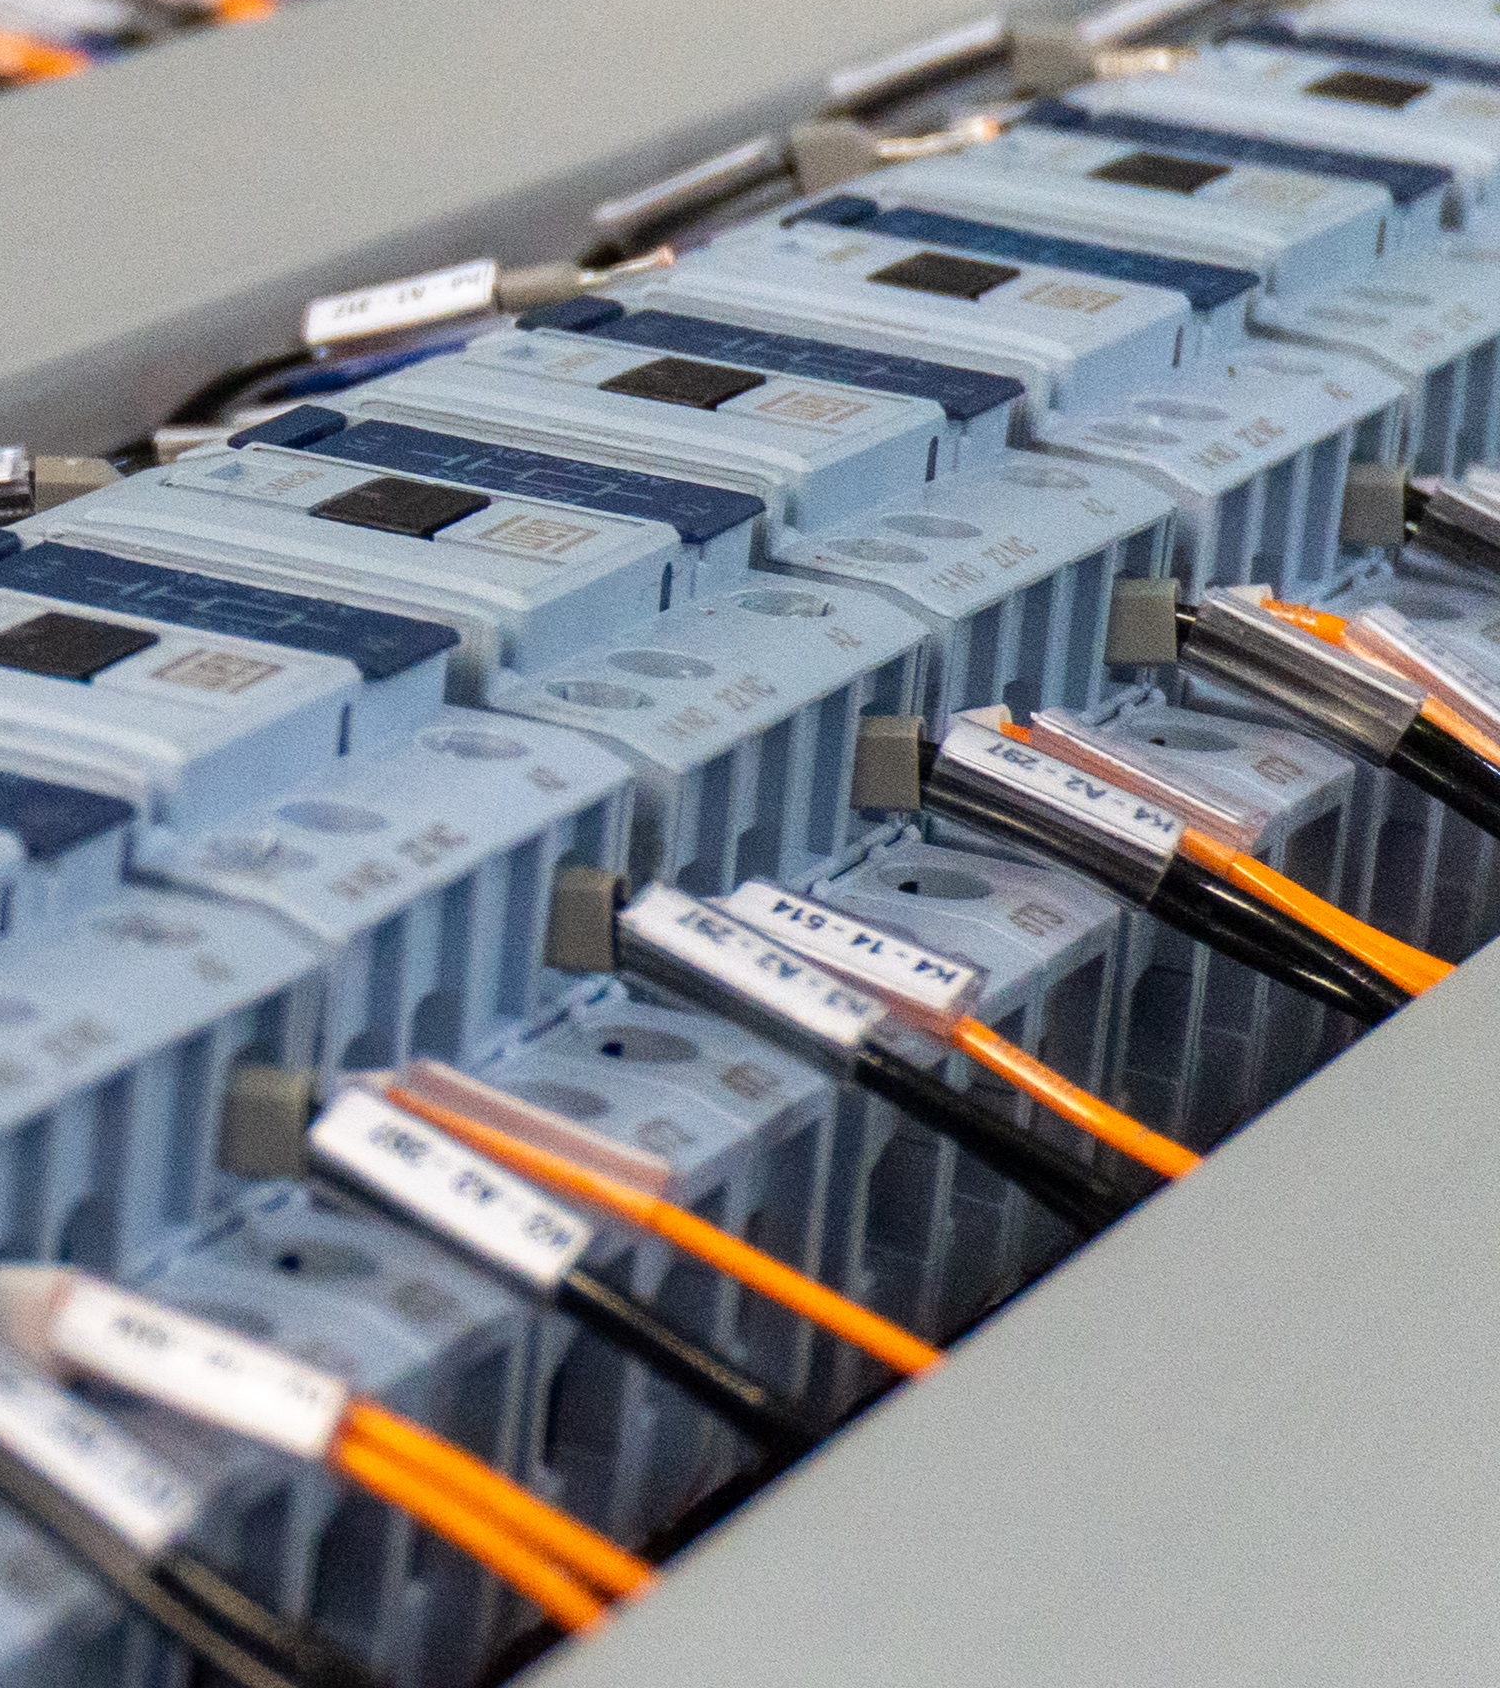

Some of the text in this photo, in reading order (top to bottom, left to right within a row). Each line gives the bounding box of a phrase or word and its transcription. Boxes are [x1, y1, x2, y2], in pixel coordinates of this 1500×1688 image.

[986, 741, 1040, 773] 297
[1063, 773, 1107, 800] A2
[1133, 805, 1176, 834] K4
[770, 898, 828, 931] 514
[850, 932, 884, 955] 14
[756, 952, 801, 980] A2
[912, 958, 958, 986] K4
